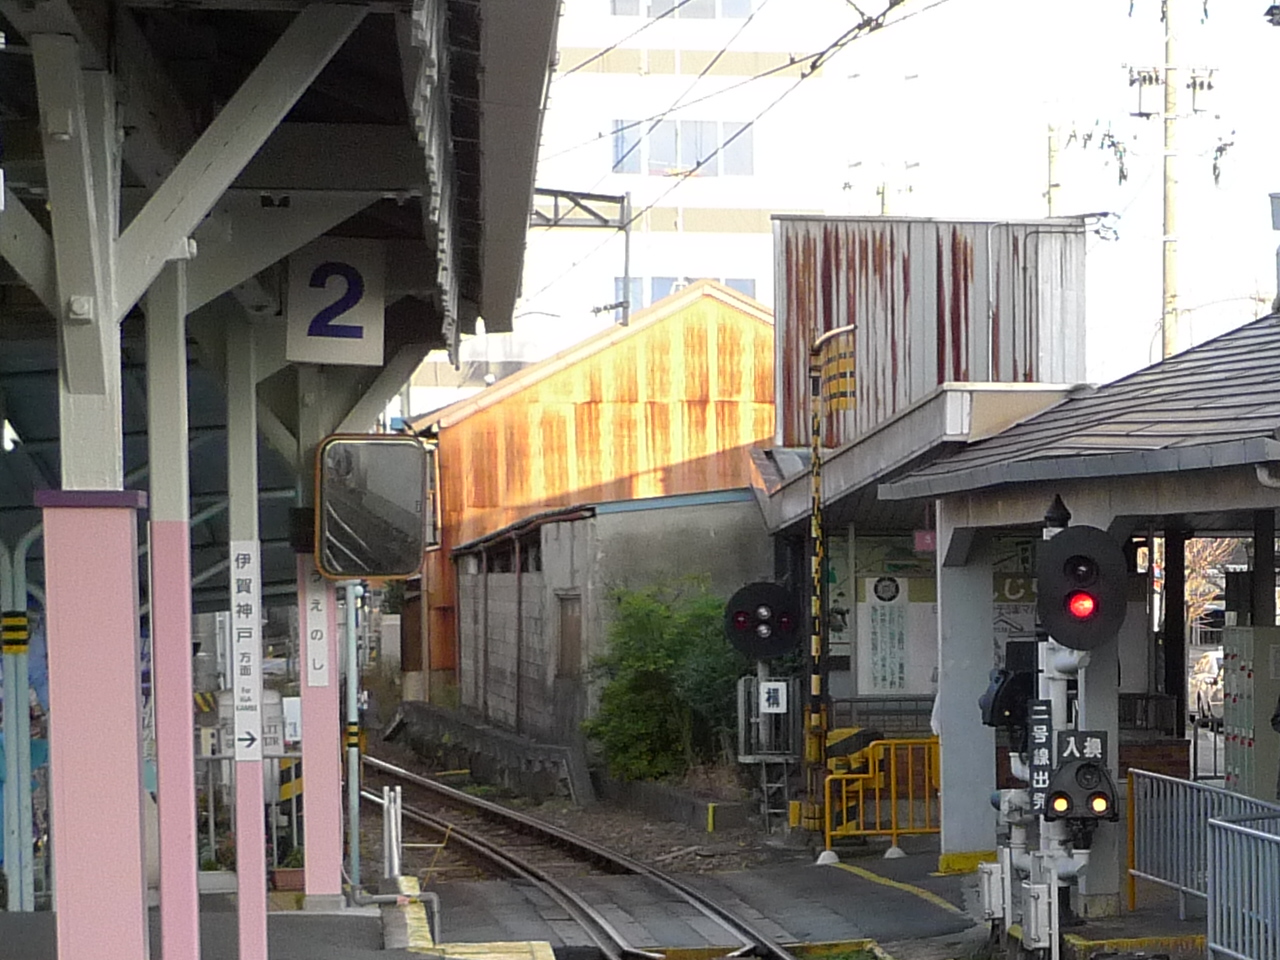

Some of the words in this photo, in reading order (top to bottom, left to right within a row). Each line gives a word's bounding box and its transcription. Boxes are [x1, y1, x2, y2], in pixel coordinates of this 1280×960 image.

[307, 261, 364, 339] 2
[1031, 705, 1050, 810] 二号線出発
